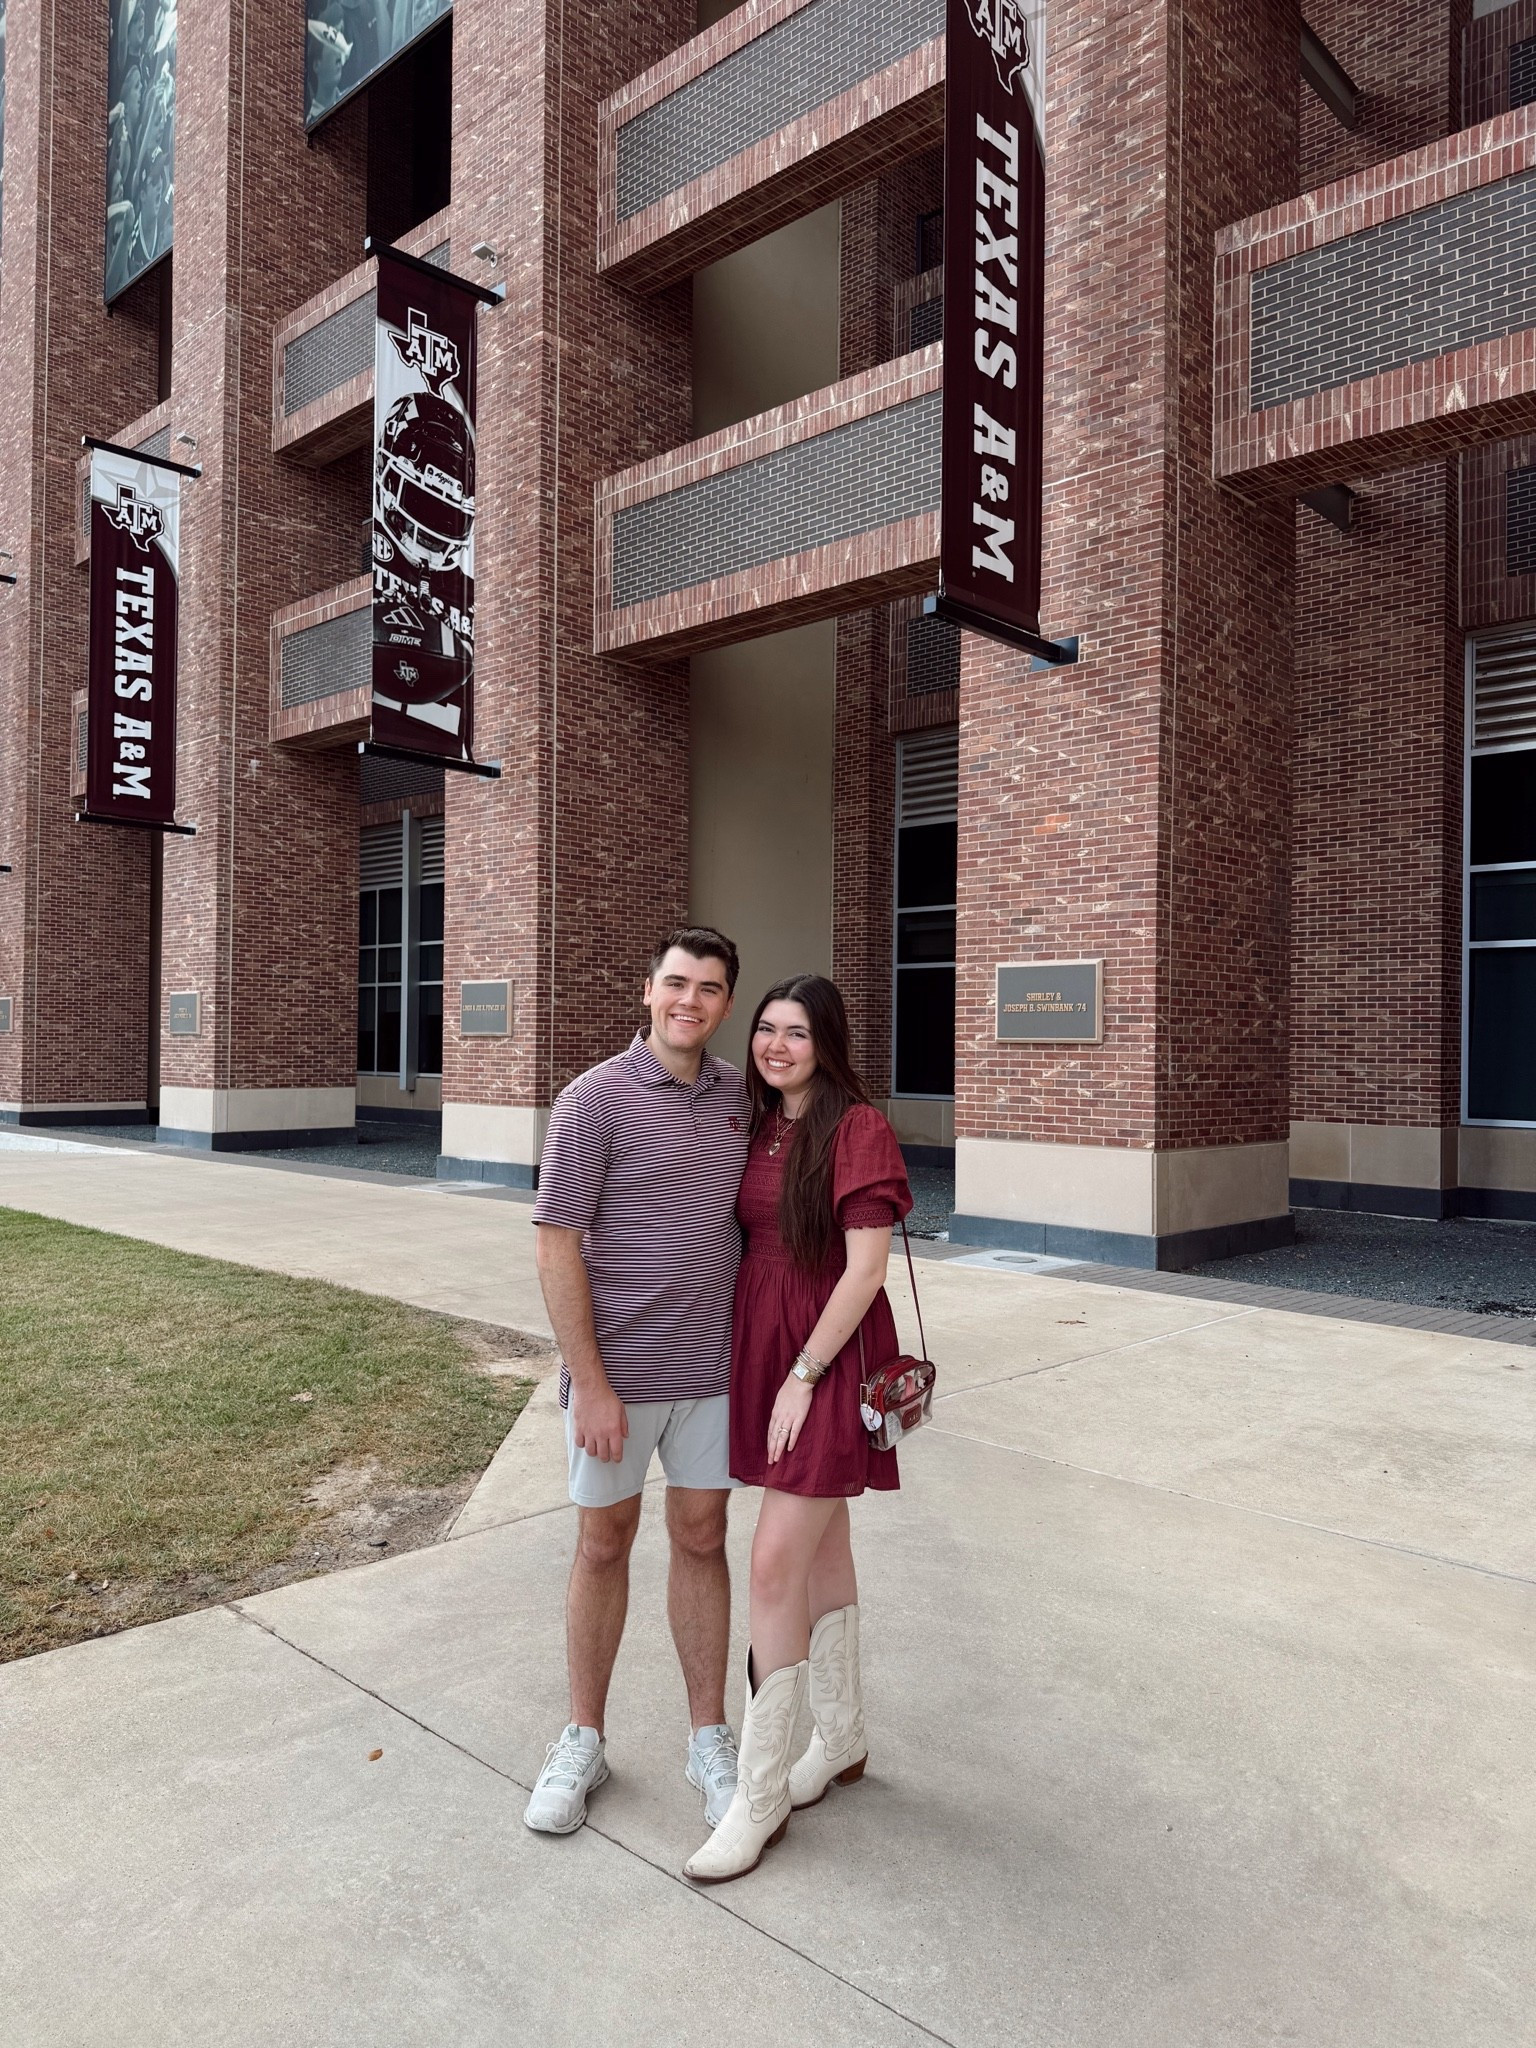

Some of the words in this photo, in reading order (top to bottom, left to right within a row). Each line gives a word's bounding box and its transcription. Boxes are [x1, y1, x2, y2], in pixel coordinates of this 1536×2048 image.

[974, 112, 1019, 390] TEXAS
[972, 403, 1017, 584] A&M
[113, 565, 155, 703] TEXAS
[112, 712, 153, 800] A&M
[1003, 1003, 1028, 1013] JOSEPH
[1036, 1003, 1074, 1012] SWINBANK
[1026, 992, 1055, 1002] SHIRLEY
[1056, 992, 1062, 1001] &
